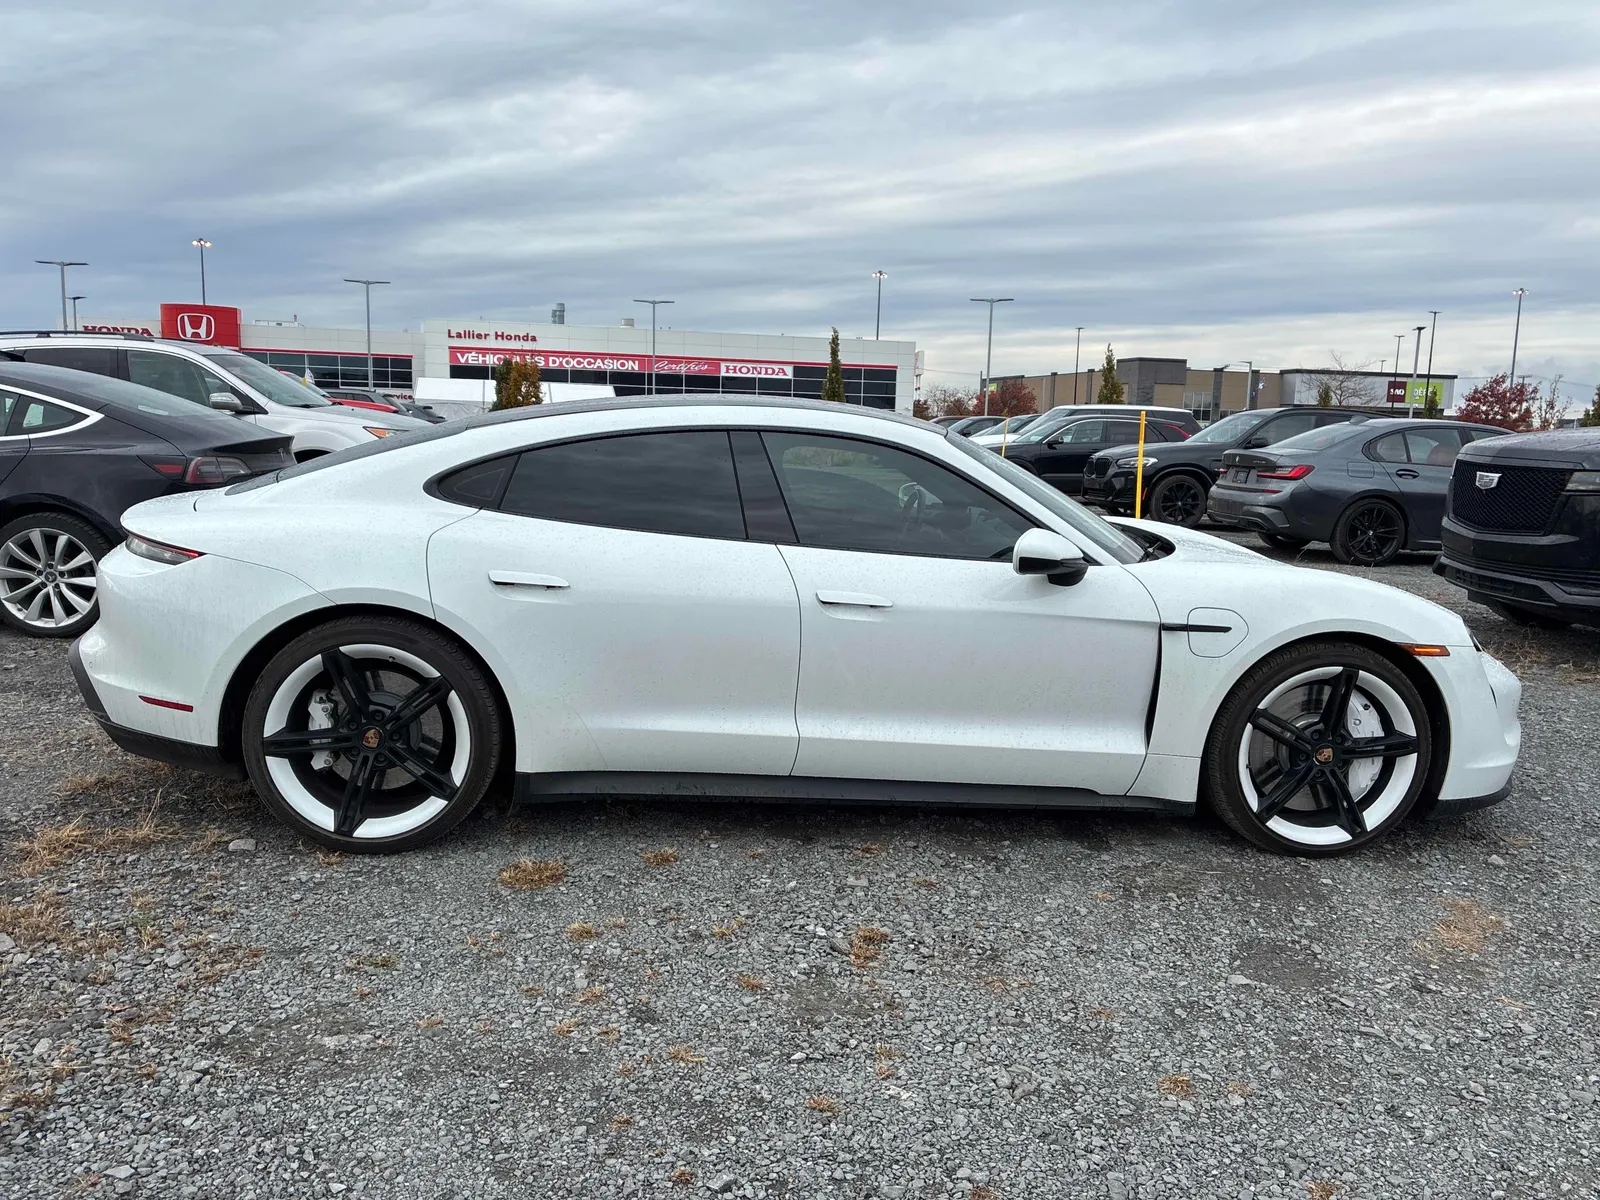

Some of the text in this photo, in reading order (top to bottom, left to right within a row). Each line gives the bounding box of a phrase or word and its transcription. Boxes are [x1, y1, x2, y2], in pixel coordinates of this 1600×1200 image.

[82, 325, 154, 336] HONDA
[448, 329, 537, 342] Lallier Honda
[549, 356, 639, 371] D'OCCASION
[724, 365, 788, 376] HONDA
